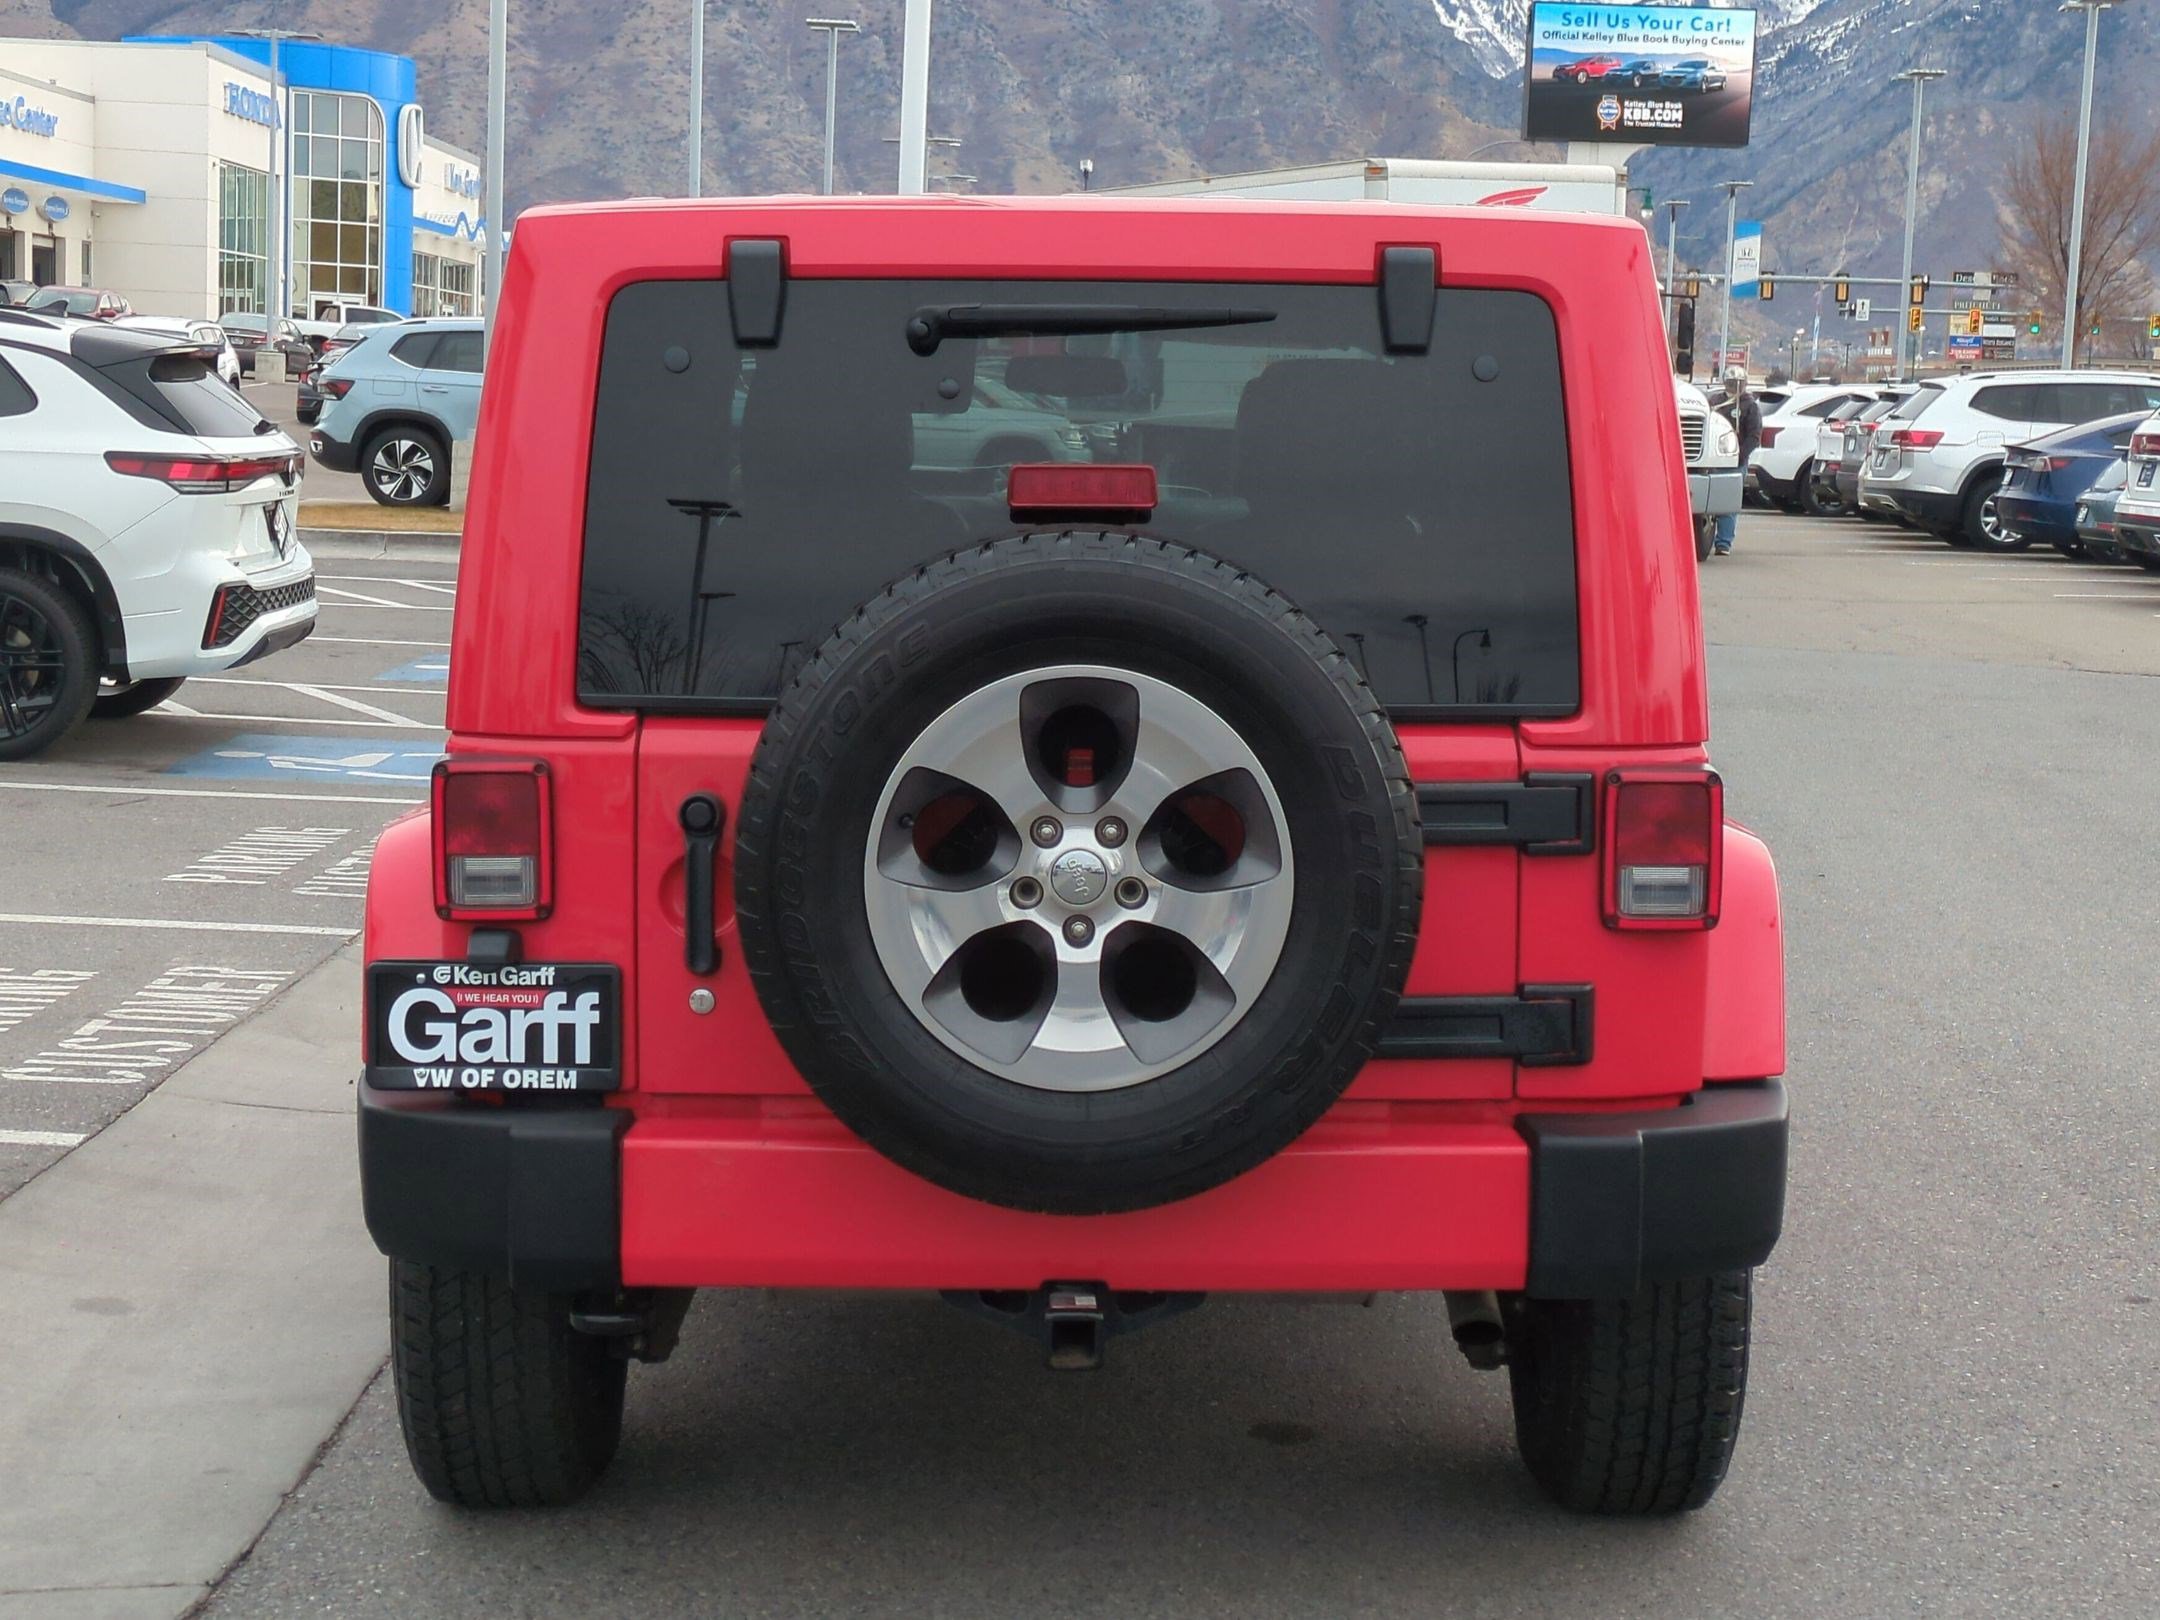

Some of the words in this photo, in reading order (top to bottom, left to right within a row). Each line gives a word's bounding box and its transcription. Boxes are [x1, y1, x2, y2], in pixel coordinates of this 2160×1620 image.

[1561, 11, 1598, 28] Sell
[1607, 13, 1630, 29] Us
[1637, 14, 1683, 31] Your
[1690, 16, 1731, 33] Car!
[1542, 30, 1579, 41] Official
[1582, 32, 1614, 44] Kelley
[1617, 33, 1640, 42] Blue
[1642, 34, 1669, 43] Book
[1672, 35, 1708, 47] Buying
[1711, 36, 1745, 46] Center
[1623, 108, 1683, 121] KBB.COM
[777, 621, 930, 1071] BRIDGESTONE
[1067, 858, 1090, 896] Jeep
[1272, 744, 1383, 1094] DUELER
[453, 966, 497, 985] Ken
[500, 966, 555, 986] Garff
[464, 993, 481, 1003] WE
[482, 993, 510, 1003] HEAR
[511, 994, 532, 1004] YOU
[1, 966, 296, 1084] CUSTOMER
[388, 987, 600, 1064] Garff
[413, 1068, 454, 1088] VW
[461, 1068, 495, 1088] OF
[502, 1069, 577, 1089] OREM
